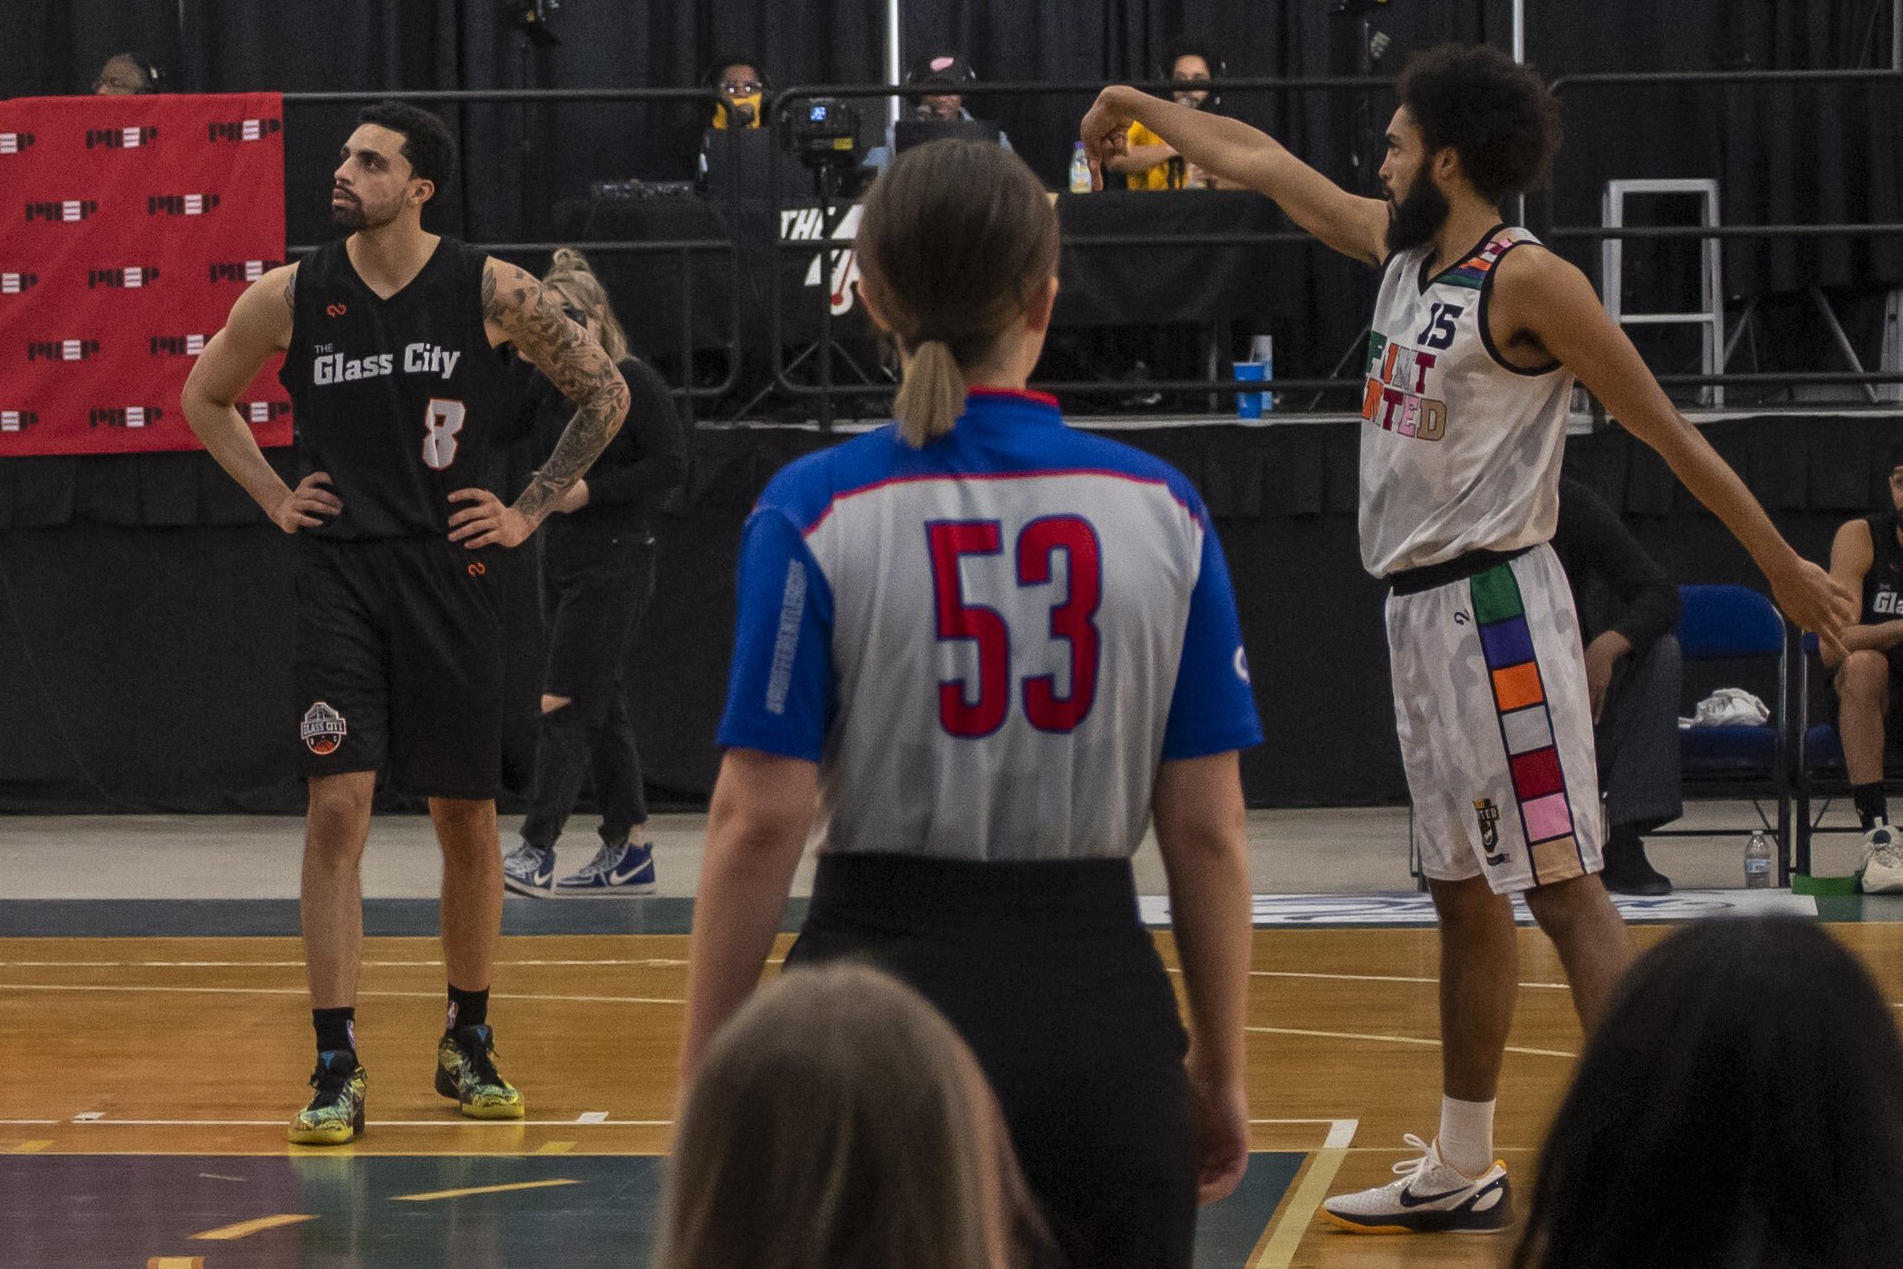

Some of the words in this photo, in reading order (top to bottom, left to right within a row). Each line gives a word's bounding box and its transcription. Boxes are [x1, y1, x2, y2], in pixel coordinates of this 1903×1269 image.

[314, 343, 334, 354] THE
[1417, 303, 1465, 351] 15
[313, 353, 394, 385] Glass
[403, 342, 461, 379] City
[1366, 331, 1437, 394] FINT
[422, 398, 466, 470] 8
[925, 513, 1102, 740] 53
